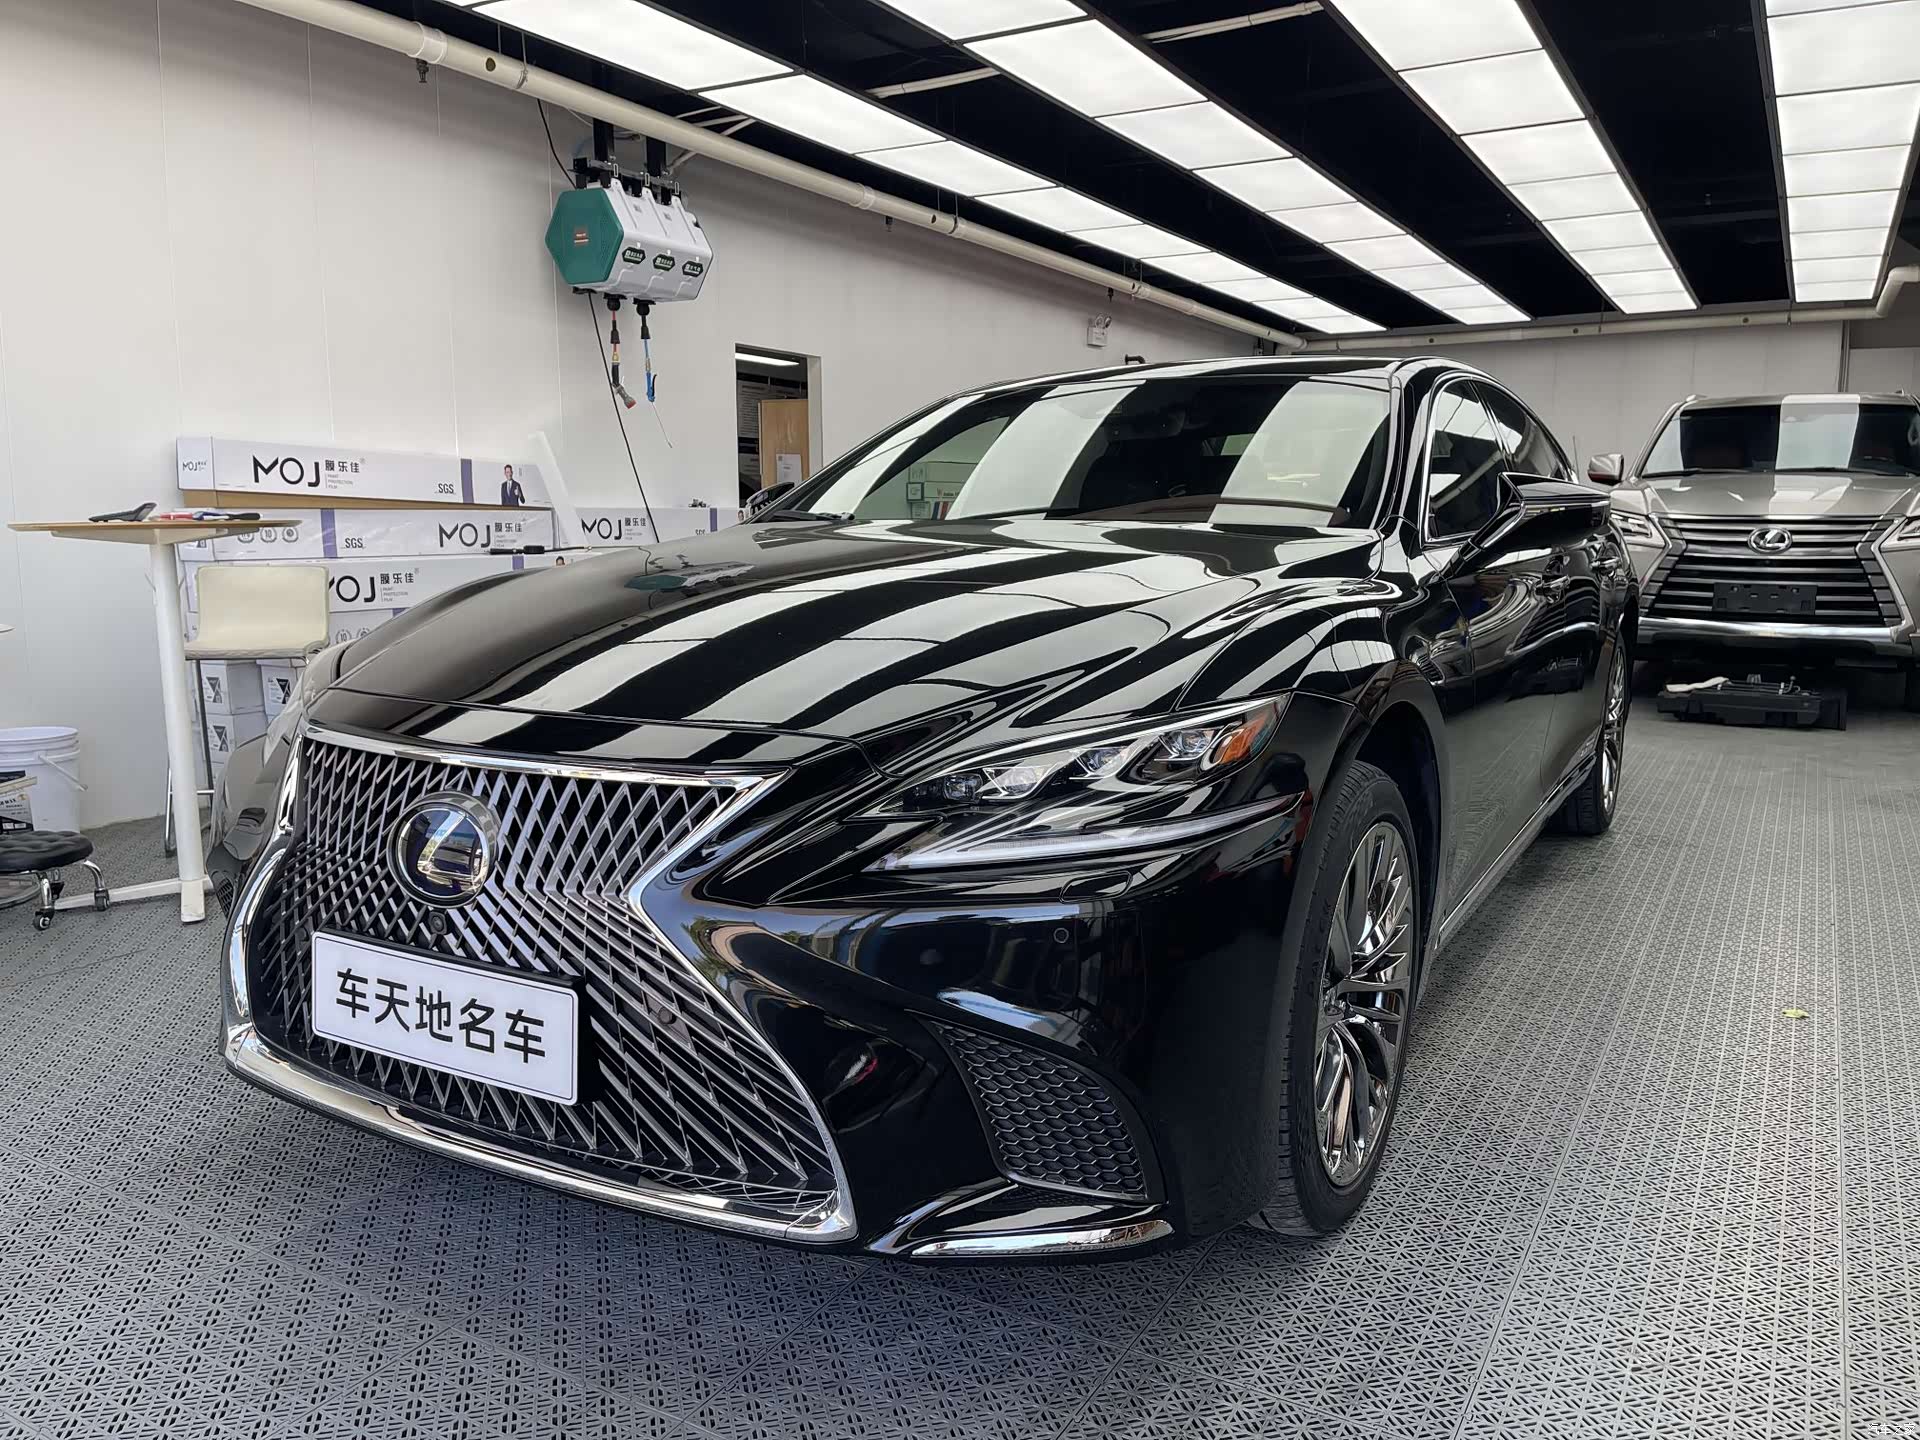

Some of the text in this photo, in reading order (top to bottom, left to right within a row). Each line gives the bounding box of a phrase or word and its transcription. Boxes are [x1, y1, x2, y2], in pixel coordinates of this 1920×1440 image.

[253, 455, 320, 487] MOJ
[325, 460, 360, 473] 膜乐佳
[438, 483, 454, 494] SGS
[439, 523, 491, 548] MOJ
[581, 518, 622, 540] MOJ
[345, 537, 363, 548] SGS
[329, 575, 376, 603] OJ
[380, 573, 414, 584] 膜乐佳
[336, 967, 546, 1064] 车天地名车
